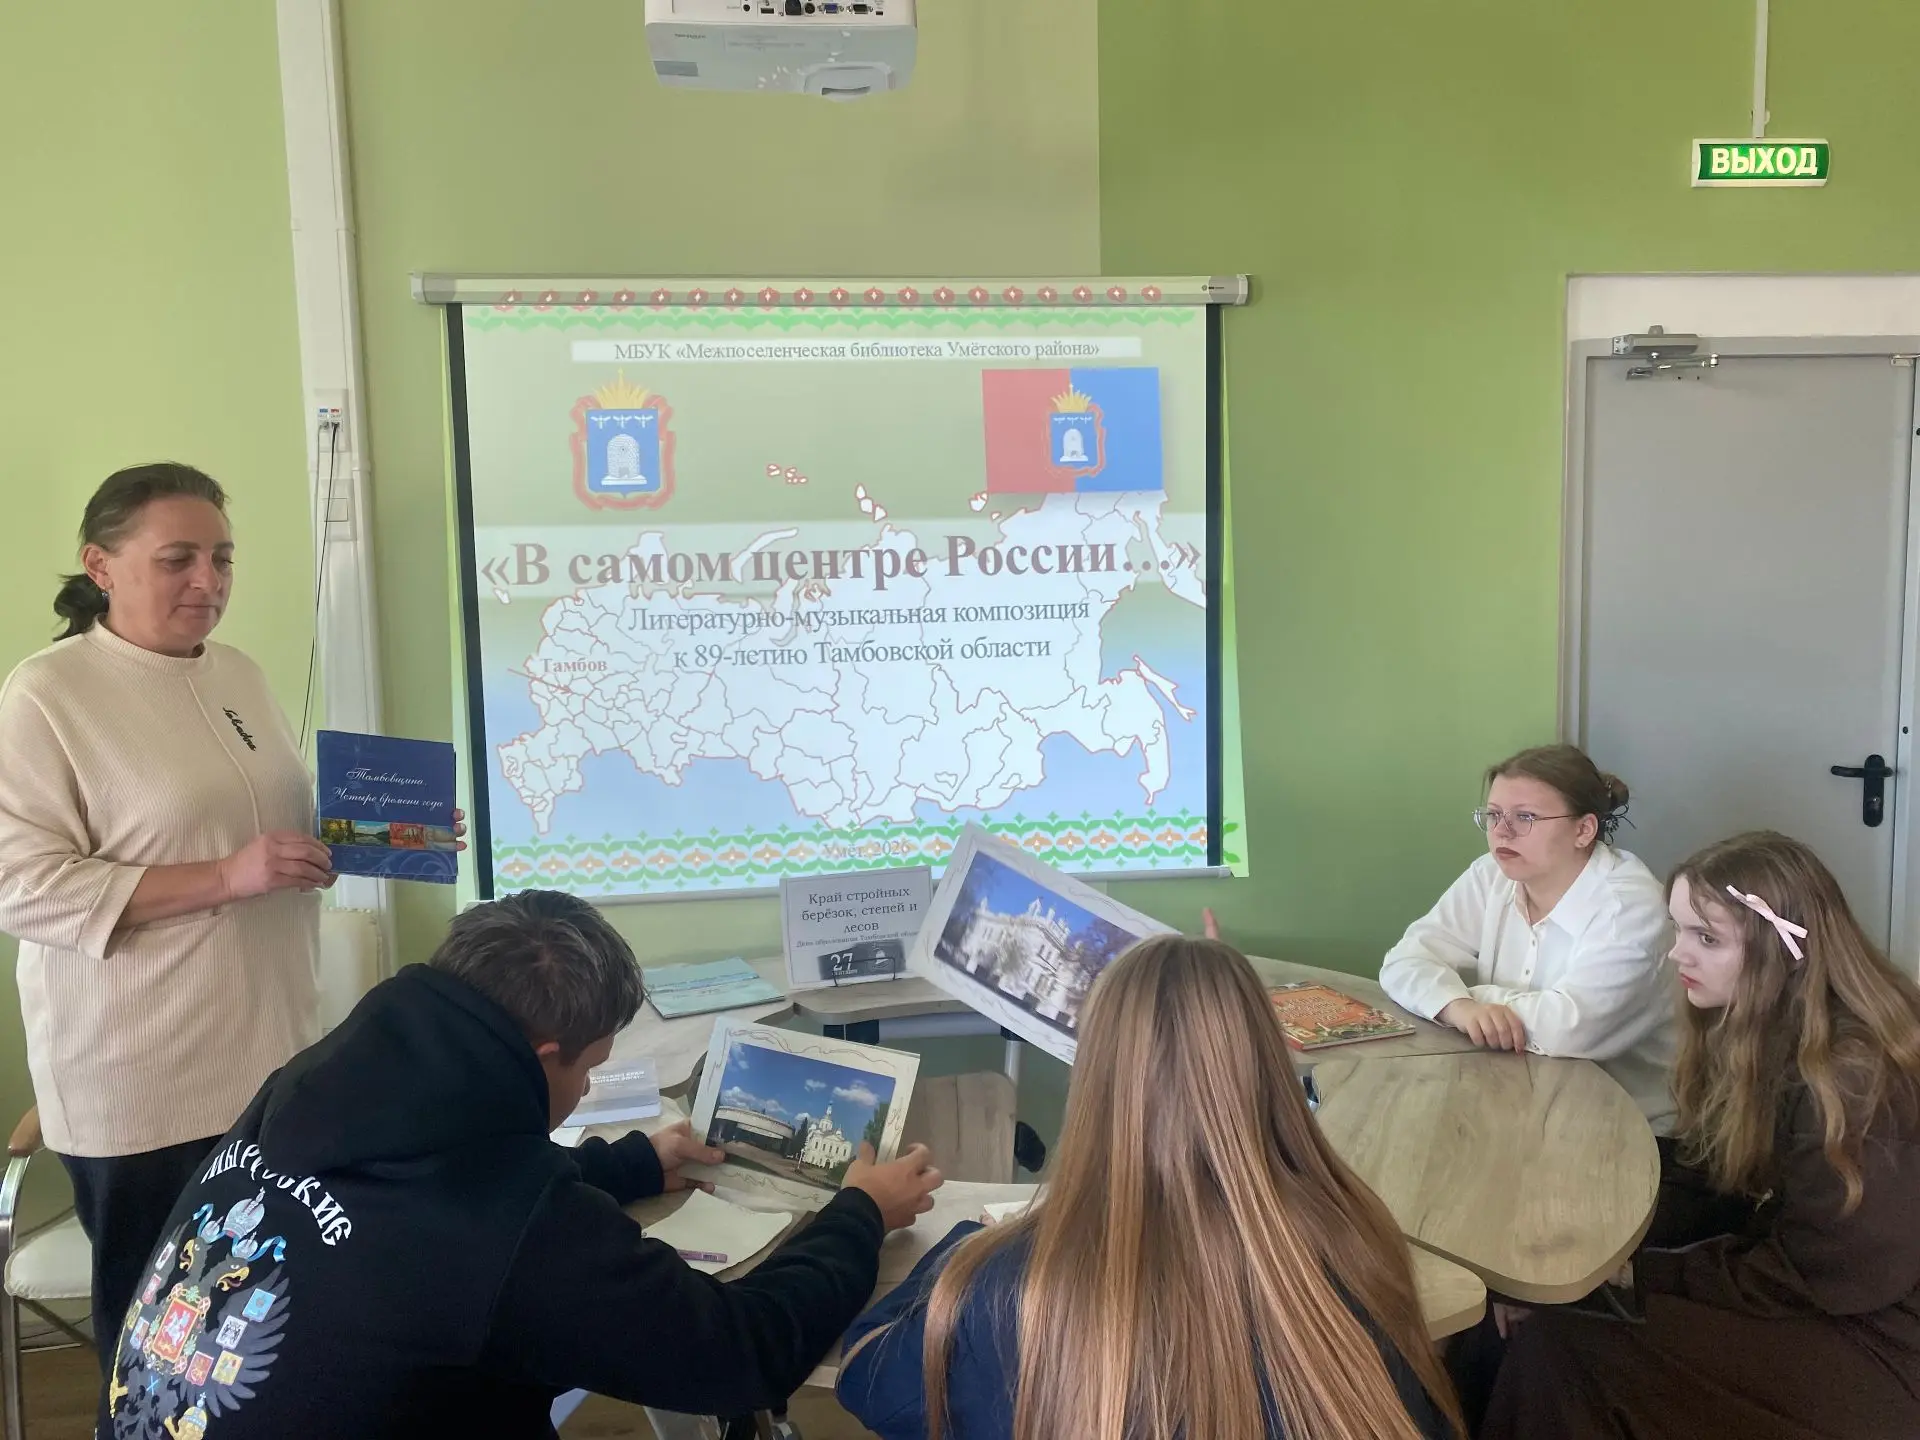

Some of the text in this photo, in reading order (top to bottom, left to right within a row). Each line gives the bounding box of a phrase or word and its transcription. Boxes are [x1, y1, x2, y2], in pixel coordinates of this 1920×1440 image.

[1711, 146, 1818, 176] ВЫХОД
[614, 341, 1101, 360] МБУК «Межпоселенческая библиотека Умётского района»
[481, 534, 1201, 592] «В самом центре России...»
[628, 602, 1090, 635] Литературно-музыкальная композиция
[674, 635, 1052, 668] к 89-летию Тамбовской области
[542, 657, 608, 673] Тамбов
[334, 786, 443, 812] Четыре времени года
[809, 887, 911, 907] Край стройных
[802, 903, 917, 923] берёзок, степей и
[844, 922, 880, 934] лесов
[830, 952, 853, 971] 27
[201, 1139, 243, 1185] МЫ
